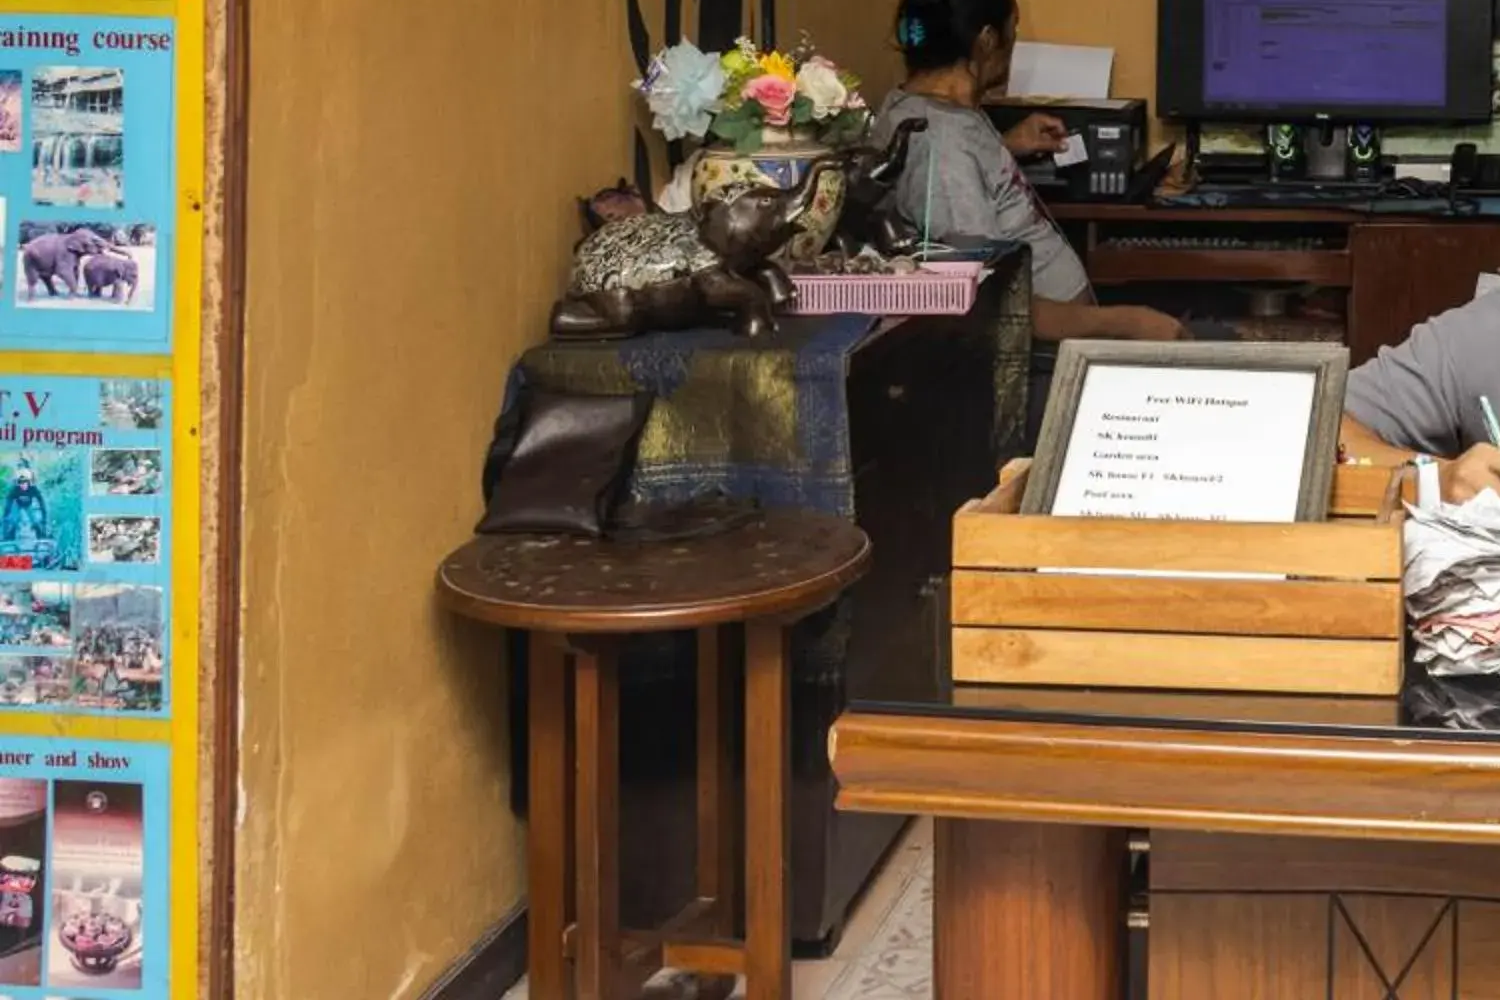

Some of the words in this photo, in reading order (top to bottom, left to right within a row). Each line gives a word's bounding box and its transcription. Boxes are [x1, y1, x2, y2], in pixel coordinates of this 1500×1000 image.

[93, 29, 171, 51] course
[23, 428, 103, 448] program
[45, 751, 77, 768] and
[88, 752, 131, 770] show
